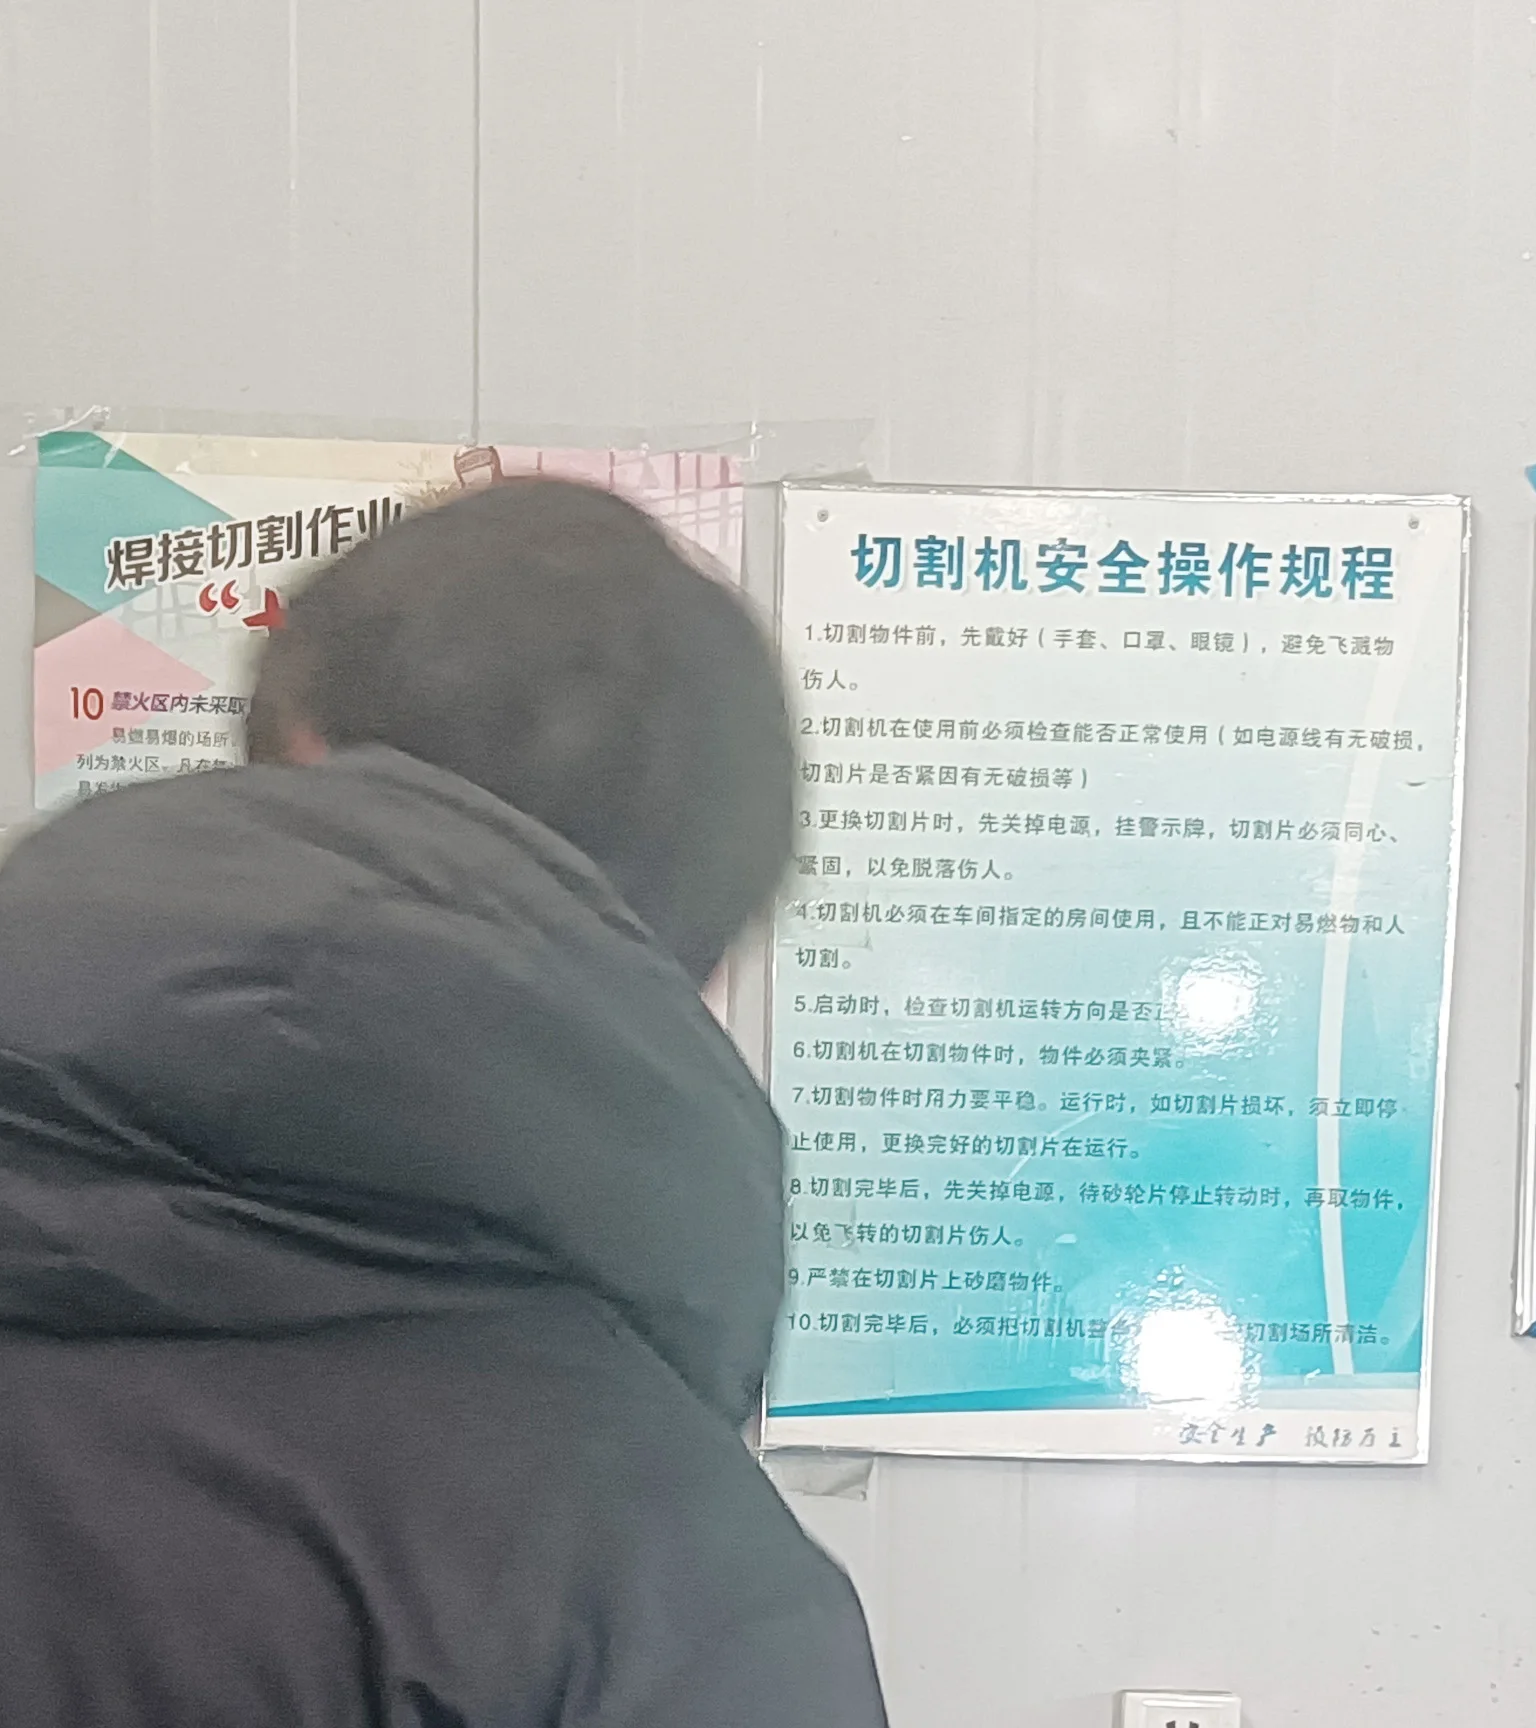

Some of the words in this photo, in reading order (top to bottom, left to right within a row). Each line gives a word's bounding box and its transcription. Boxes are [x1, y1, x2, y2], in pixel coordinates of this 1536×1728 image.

[851, 533, 1396, 601] 切割机安全操作规程
[801, 669, 860, 692] 伤人。
[70, 686, 104, 721] 10
[795, 948, 852, 971] 切割。
